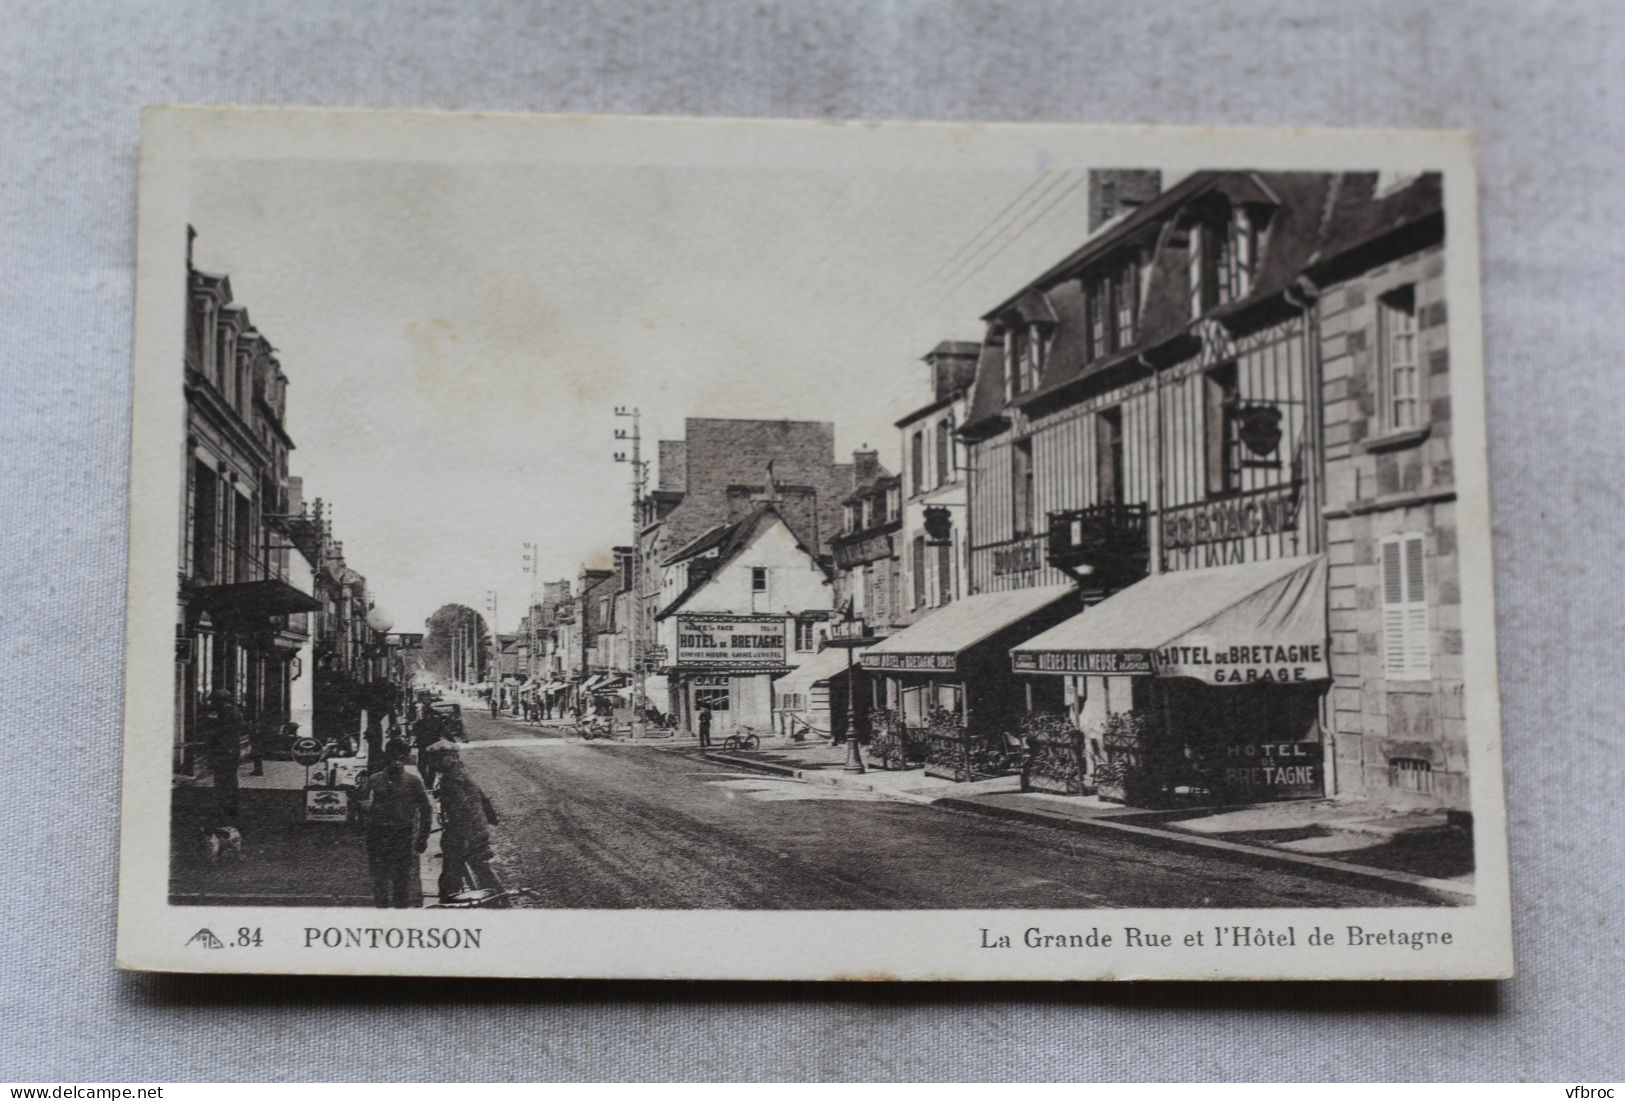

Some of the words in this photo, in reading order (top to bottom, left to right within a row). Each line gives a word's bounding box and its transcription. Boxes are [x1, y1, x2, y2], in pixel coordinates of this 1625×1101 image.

[680, 634, 717, 648] HOTEL
[731, 635, 784, 648] BRETAGNE
[1088, 654, 1117, 672] MEUSE
[1158, 646, 1212, 665] HOTEL
[1214, 652, 1230, 664] DE
[1229, 645, 1321, 665] BRETAGNE
[1214, 668, 1306, 683] GARAGE
[1227, 744, 1307, 757] HOTEL
[1226, 766, 1315, 785] BRETAGNE
[304, 926, 483, 949] PONTORSON
[979, 928, 1012, 949] La
[1023, 926, 1113, 949] Grande
[1123, 926, 1173, 948] Rue
[1183, 929, 1205, 947] et
[1214, 926, 1297, 947] l'Hôtel
[1308, 926, 1335, 946] de
[1346, 925, 1454, 950] Bretagne
